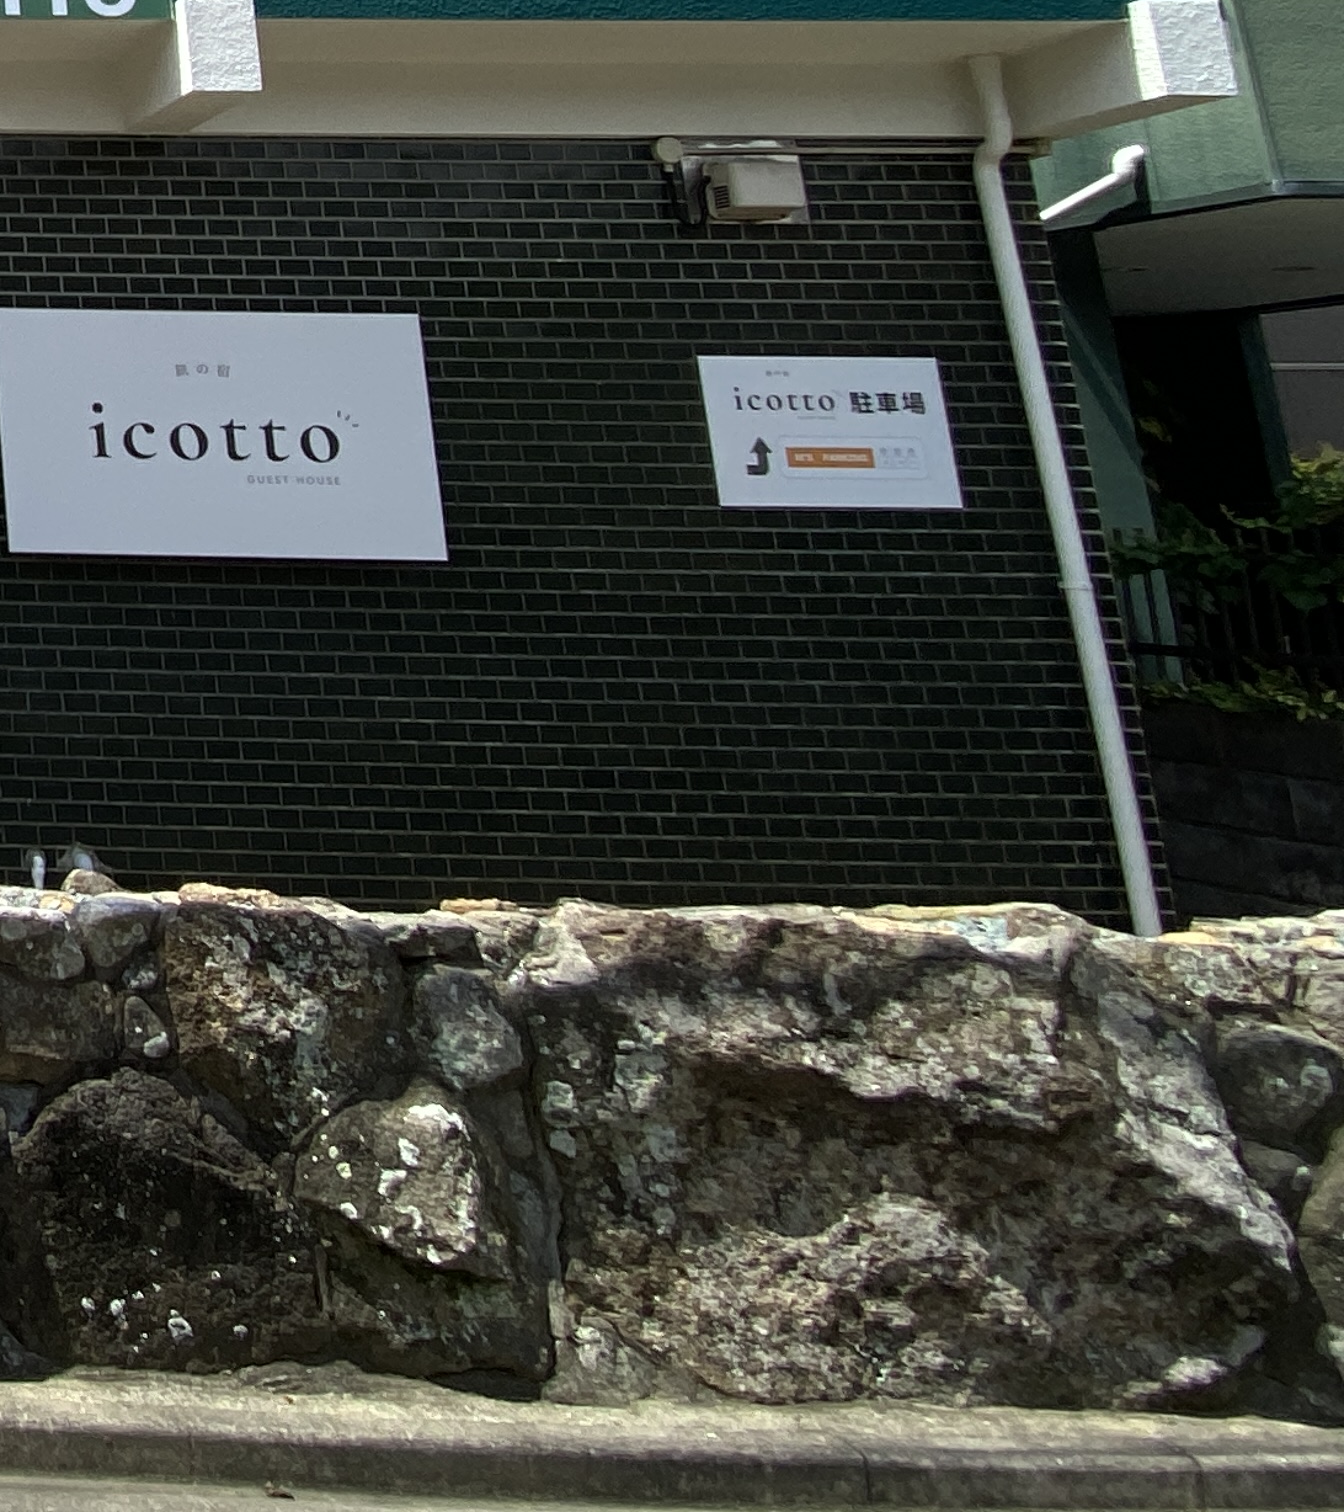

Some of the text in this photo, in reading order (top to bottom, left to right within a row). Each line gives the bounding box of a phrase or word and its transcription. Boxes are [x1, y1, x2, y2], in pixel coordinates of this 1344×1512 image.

[734, 386, 926, 414] icotto 駐車場
[89, 402, 340, 463] icotto
[246, 474, 341, 486] GUEST HOUSE
